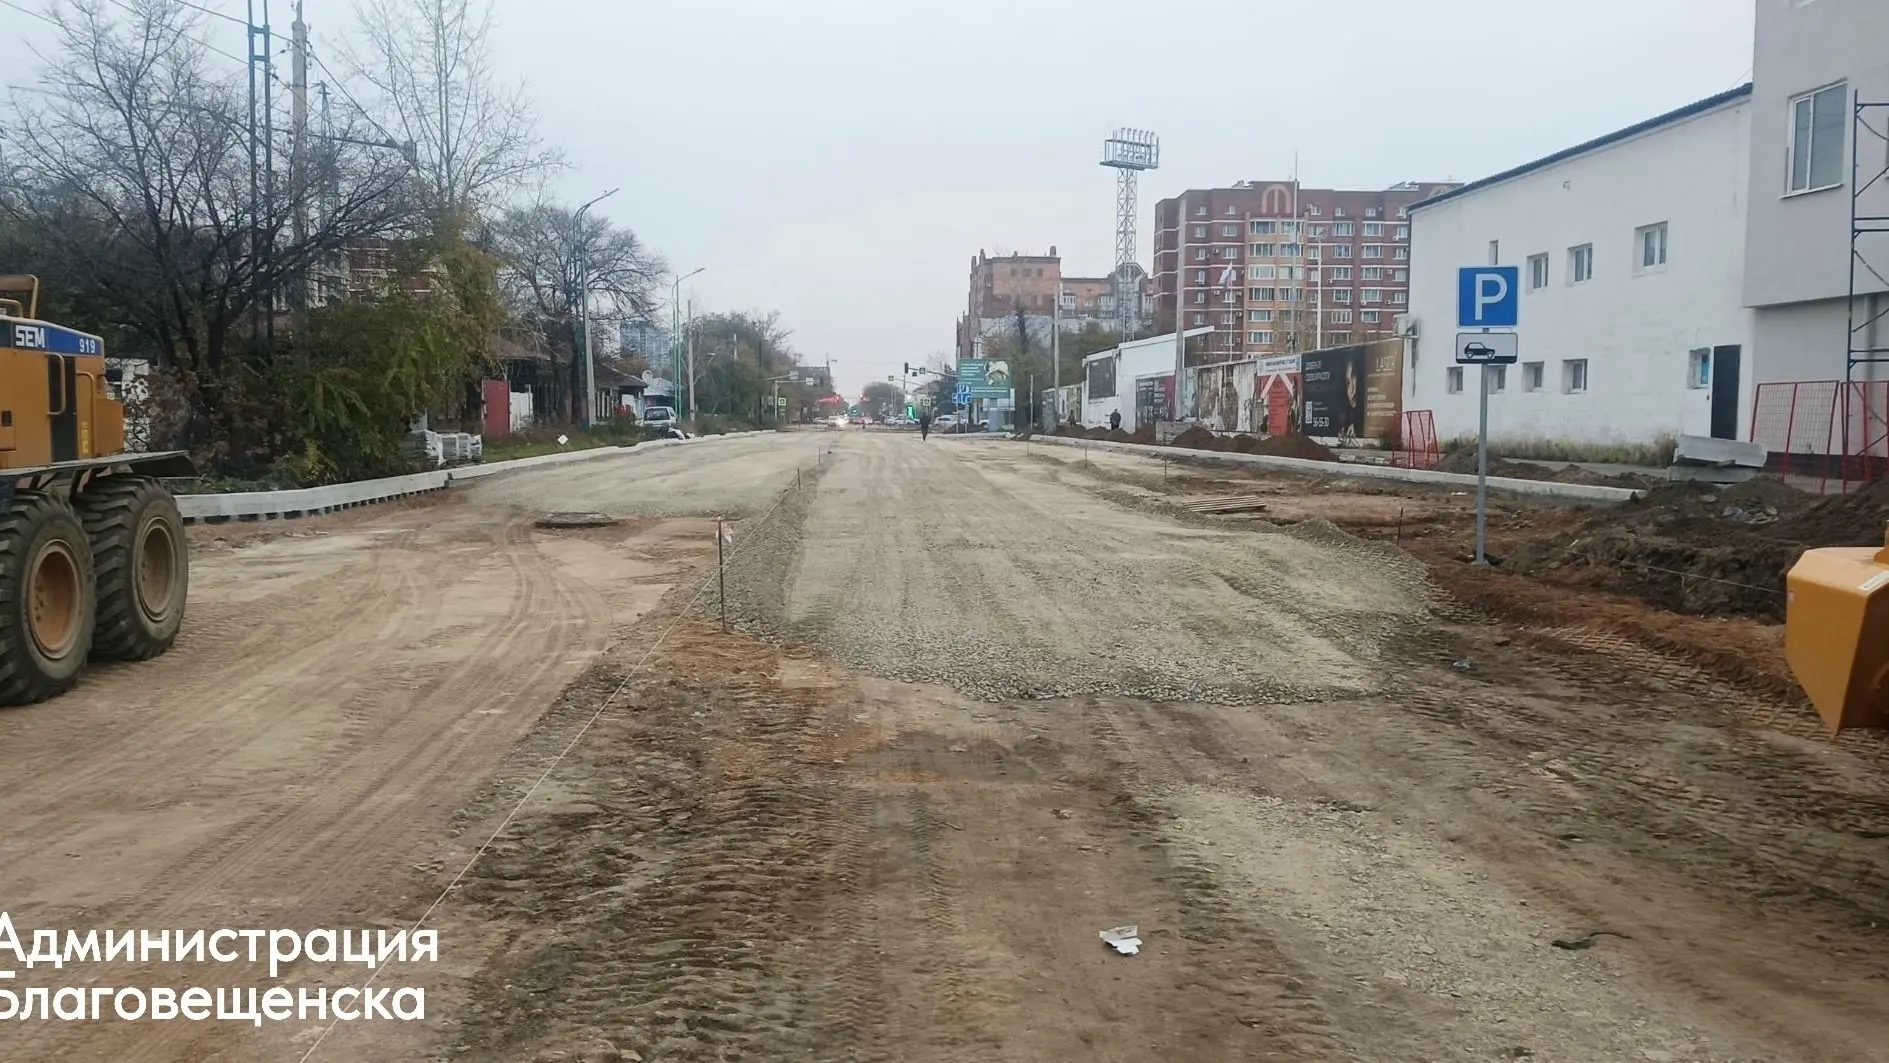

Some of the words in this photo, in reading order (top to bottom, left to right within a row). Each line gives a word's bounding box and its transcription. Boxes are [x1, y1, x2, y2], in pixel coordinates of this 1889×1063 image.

[1475, 273, 1508, 321] P
[15, 324, 46, 348] SEM
[79, 338, 96, 354] 919
